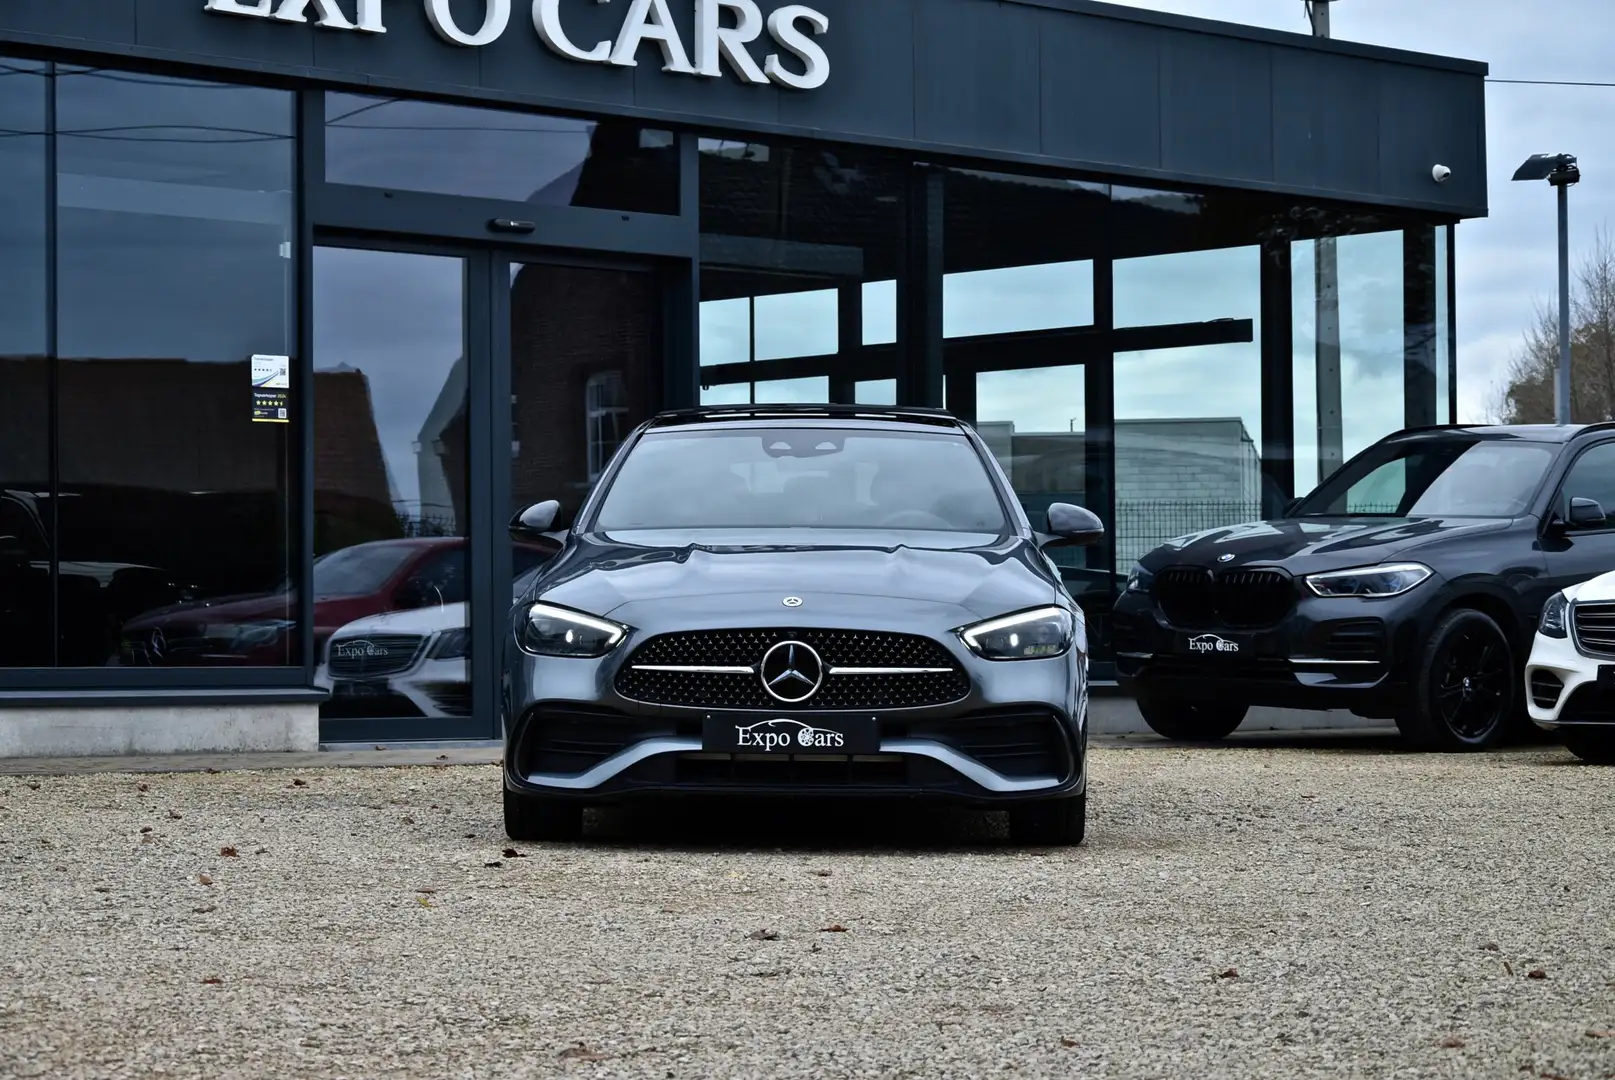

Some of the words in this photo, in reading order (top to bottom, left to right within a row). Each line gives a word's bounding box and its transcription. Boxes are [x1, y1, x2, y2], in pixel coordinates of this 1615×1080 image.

[531, 0, 830, 89] CARS
[337, 646, 364, 659] Expo
[366, 645, 389, 656] Cars
[1188, 638, 1213, 654] Expo
[1216, 639, 1239, 652] Cars
[736, 727, 791, 751] Expo
[797, 727, 844, 747] Cars
